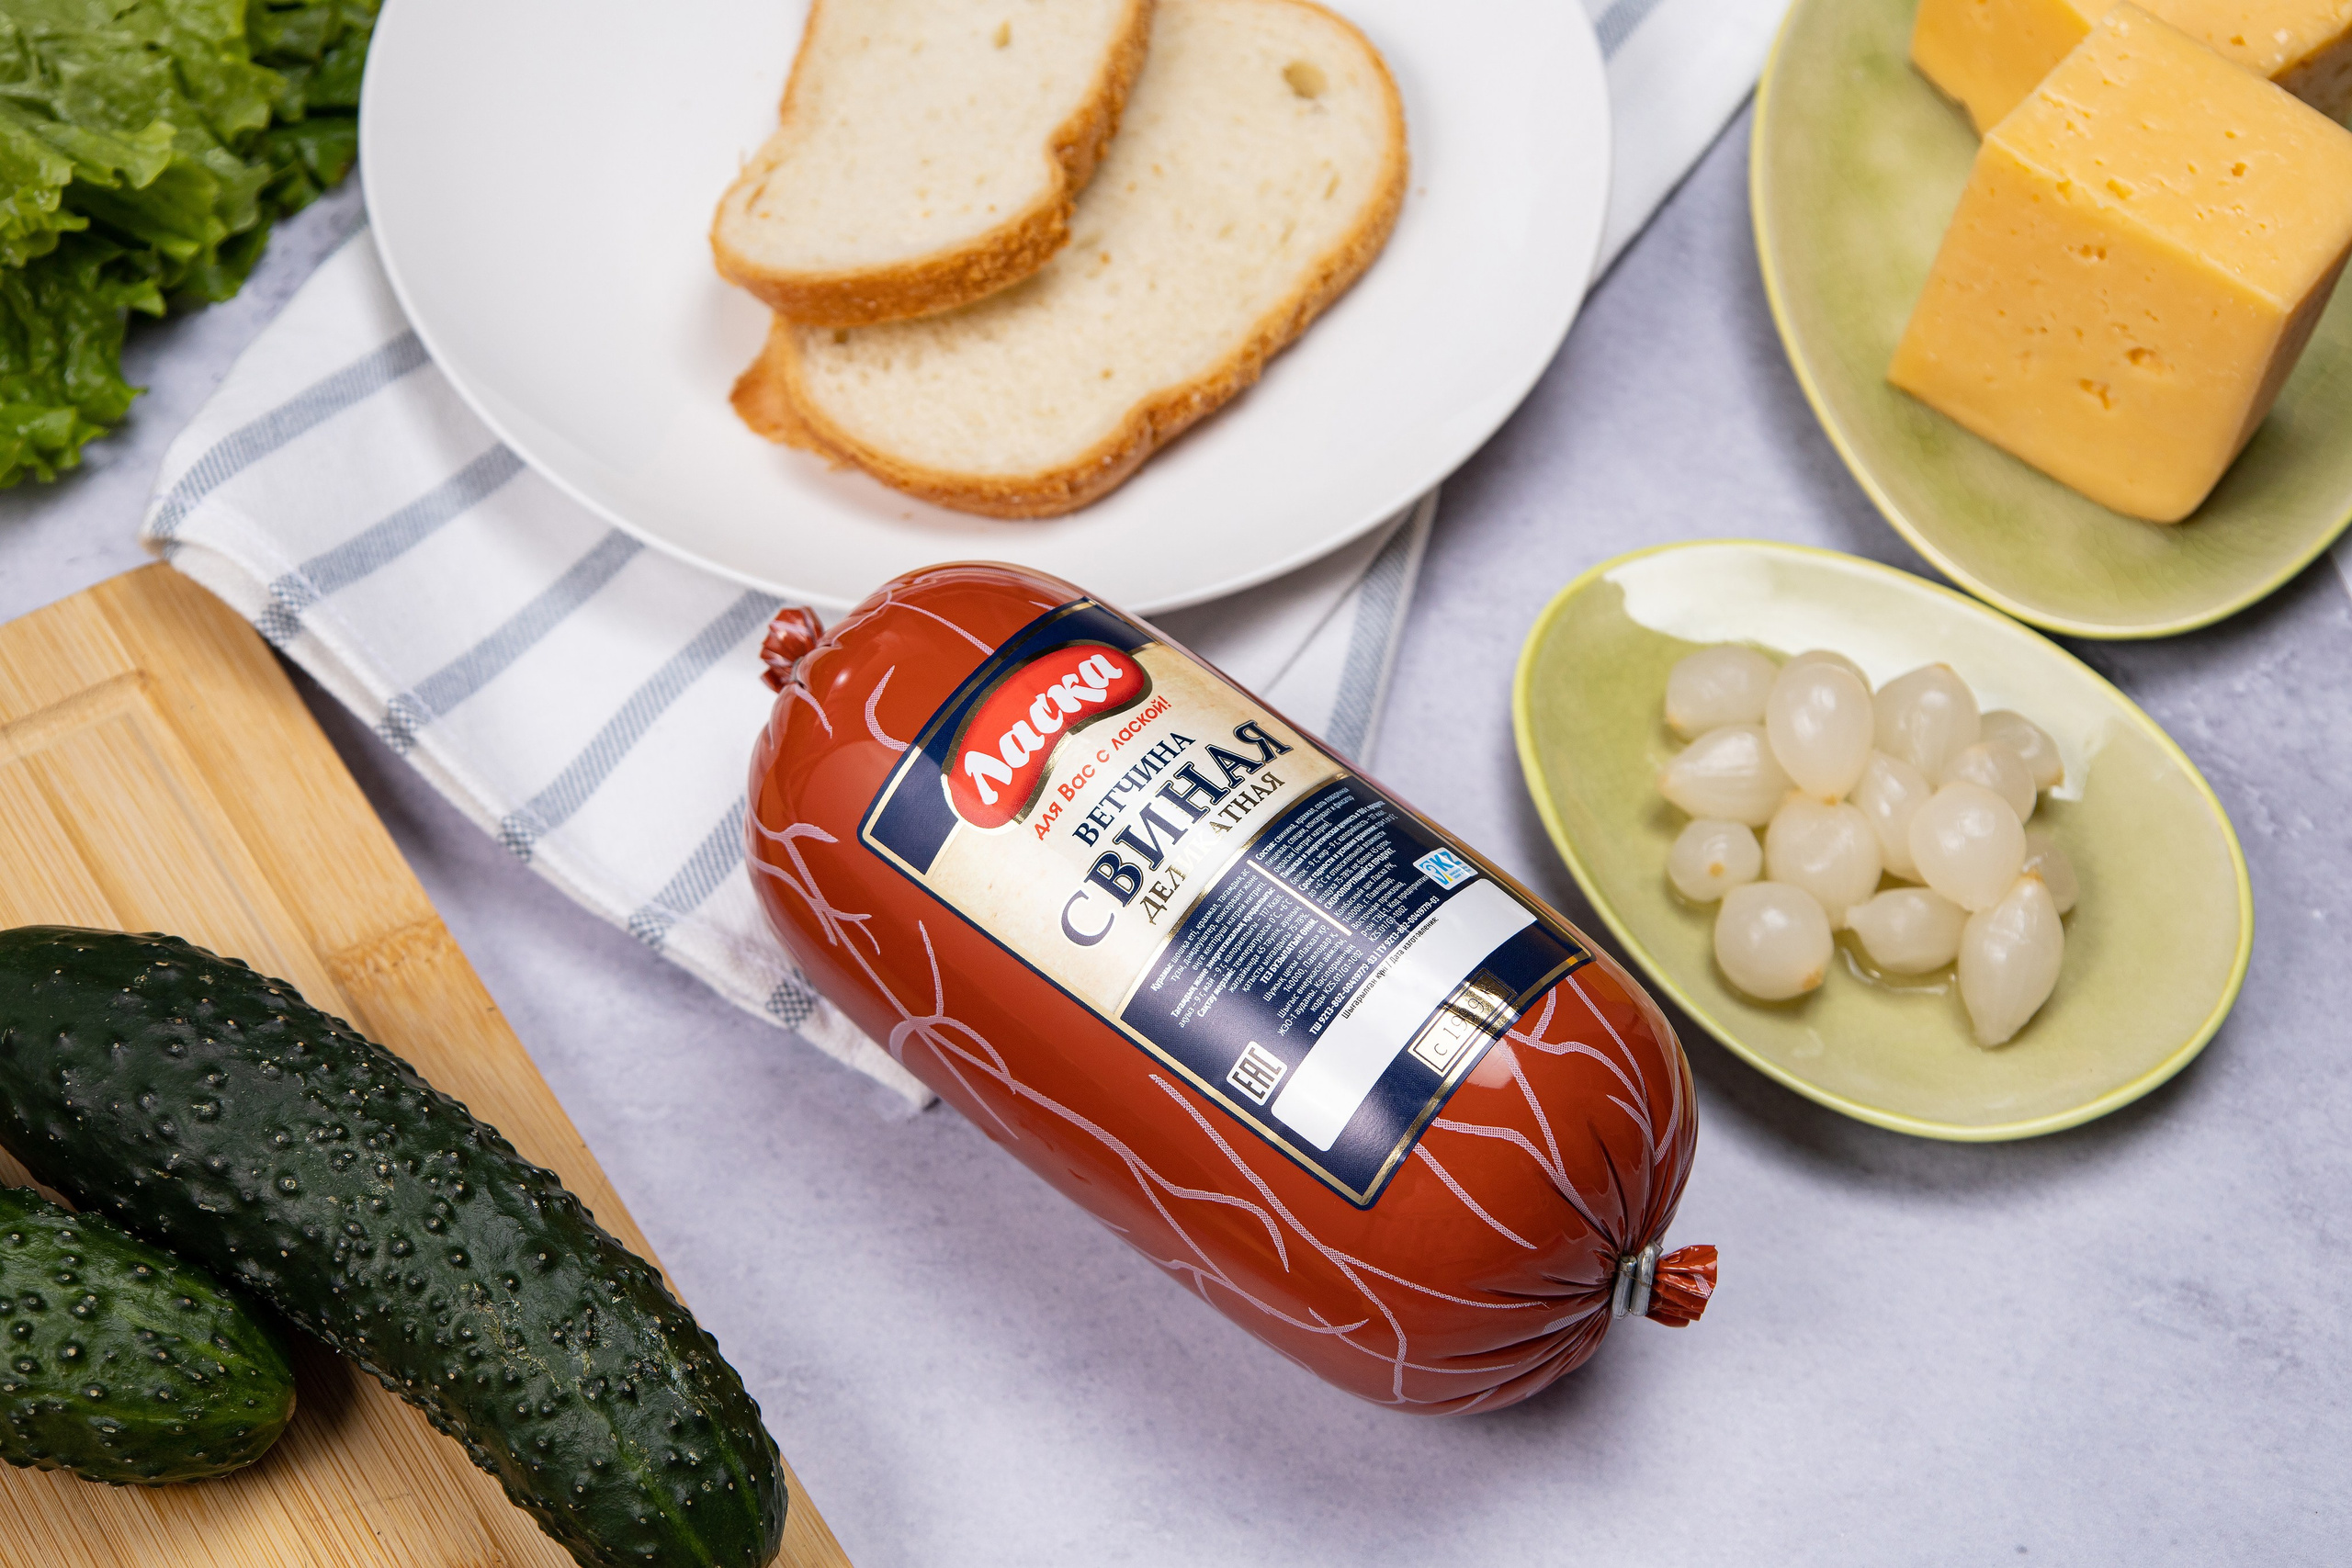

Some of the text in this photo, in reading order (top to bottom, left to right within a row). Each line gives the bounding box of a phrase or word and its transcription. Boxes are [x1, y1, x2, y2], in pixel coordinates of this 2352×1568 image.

[964, 654, 1123, 805] Ласка
[1035, 695, 1172, 840] для Вас с лаской!
[1072, 732, 1196, 847] ВЕТЧИНА
[1060, 719, 1294, 947] СВИНАЯ
[1140, 772, 1285, 925] ДЕЛИКАТНАЯ
[1255, 841, 1277, 860] Состав:
[1274, 823, 1298, 842] свинина,
[1295, 807, 1318, 824] крахмал,
[1264, 844, 1291, 868] пищевая,
[1287, 828, 1308, 844] специи,
[1272, 852, 1295, 873] окраски
[1291, 835, 1313, 853] (нитрит
[1329, 845, 1364, 875] относительной
[1278, 857, 1304, 879] Пищевая
[1289, 868, 1307, 885] белок
[1316, 849, 1329, 860] жир
[1297, 876, 1314, 891] Срок
[1311, 856, 1335, 878] годности
[1336, 838, 1357, 857] условия
[1315, 883, 1338, 905] воздуха
[1333, 867, 1353, 884] 75-78%
[1356, 852, 1373, 864] более
[1321, 862, 1374, 909] СКОРОПОРТЯЩИЙСЯ
[1430, 851, 1462, 872] KZ
[1169, 940, 1189, 964] шошқа
[1187, 930, 1199, 941] еті,
[1195, 903, 1221, 930] крахмал,
[1217, 874, 1245, 902] тағамдық
[1214, 888, 1244, 923] консервант
[1242, 874, 1258, 890] және
[1331, 888, 1364, 919] Колбасный
[1362, 880, 1374, 890] цех
[1370, 868, 1388, 882] Ласка
[1341, 903, 1366, 923] 140000,
[1365, 877, 1395, 900] Павлодар,
[1349, 881, 1406, 930] Восточная промзона,
[1360, 921, 1375, 936] р-он
[1386, 898, 1401, 908] Код
[1191, 881, 1266, 970] өңге келтіруші натрий нитриті.
[1202, 977, 1215, 992] май
[1223, 921, 1259, 963] калориялығы
[1259, 907, 1269, 917] 117
[1266, 894, 1283, 909] Ккал.
[1227, 953, 1260, 993] жағдайында
[1263, 927, 1283, 946] тәулік,
[1280, 905, 1302, 927] ауаның
[1241, 912, 1310, 992] қатысты ылғалдығы 75-78%.
[1259, 970, 1272, 983] ТЕЗ
[1300, 918, 1318, 935] ӨНІМ.
[1366, 905, 1407, 943] KZS.01/G1-1002
[1170, 985, 1198, 1017] Тағамдық
[1193, 968, 1208, 987] және
[1205, 921, 1246, 969] энергетикалық
[1213, 967, 1235, 995] мерзімі:
[1232, 920, 1272, 968] температурасы
[1276, 937, 1347, 1018] Шығыс өнеркәсіп аймағы,
[1282, 959, 1298, 977] цехы
[1296, 934, 1319, 959] «Ласка»
[1283, 968, 1307, 992] 140000,
[1302, 936, 1331, 967] Павлодар
[1310, 948, 1365, 1011] коды KZS.01/G1-1002
[1341, 979, 1376, 1019] Шығарылған
[1389, 949, 1404, 964] Дата
[1402, 916, 1438, 950] изготовления:
[1277, 942, 1357, 1036] ЖЭО-1 ауданы. Кәсіпорынның
